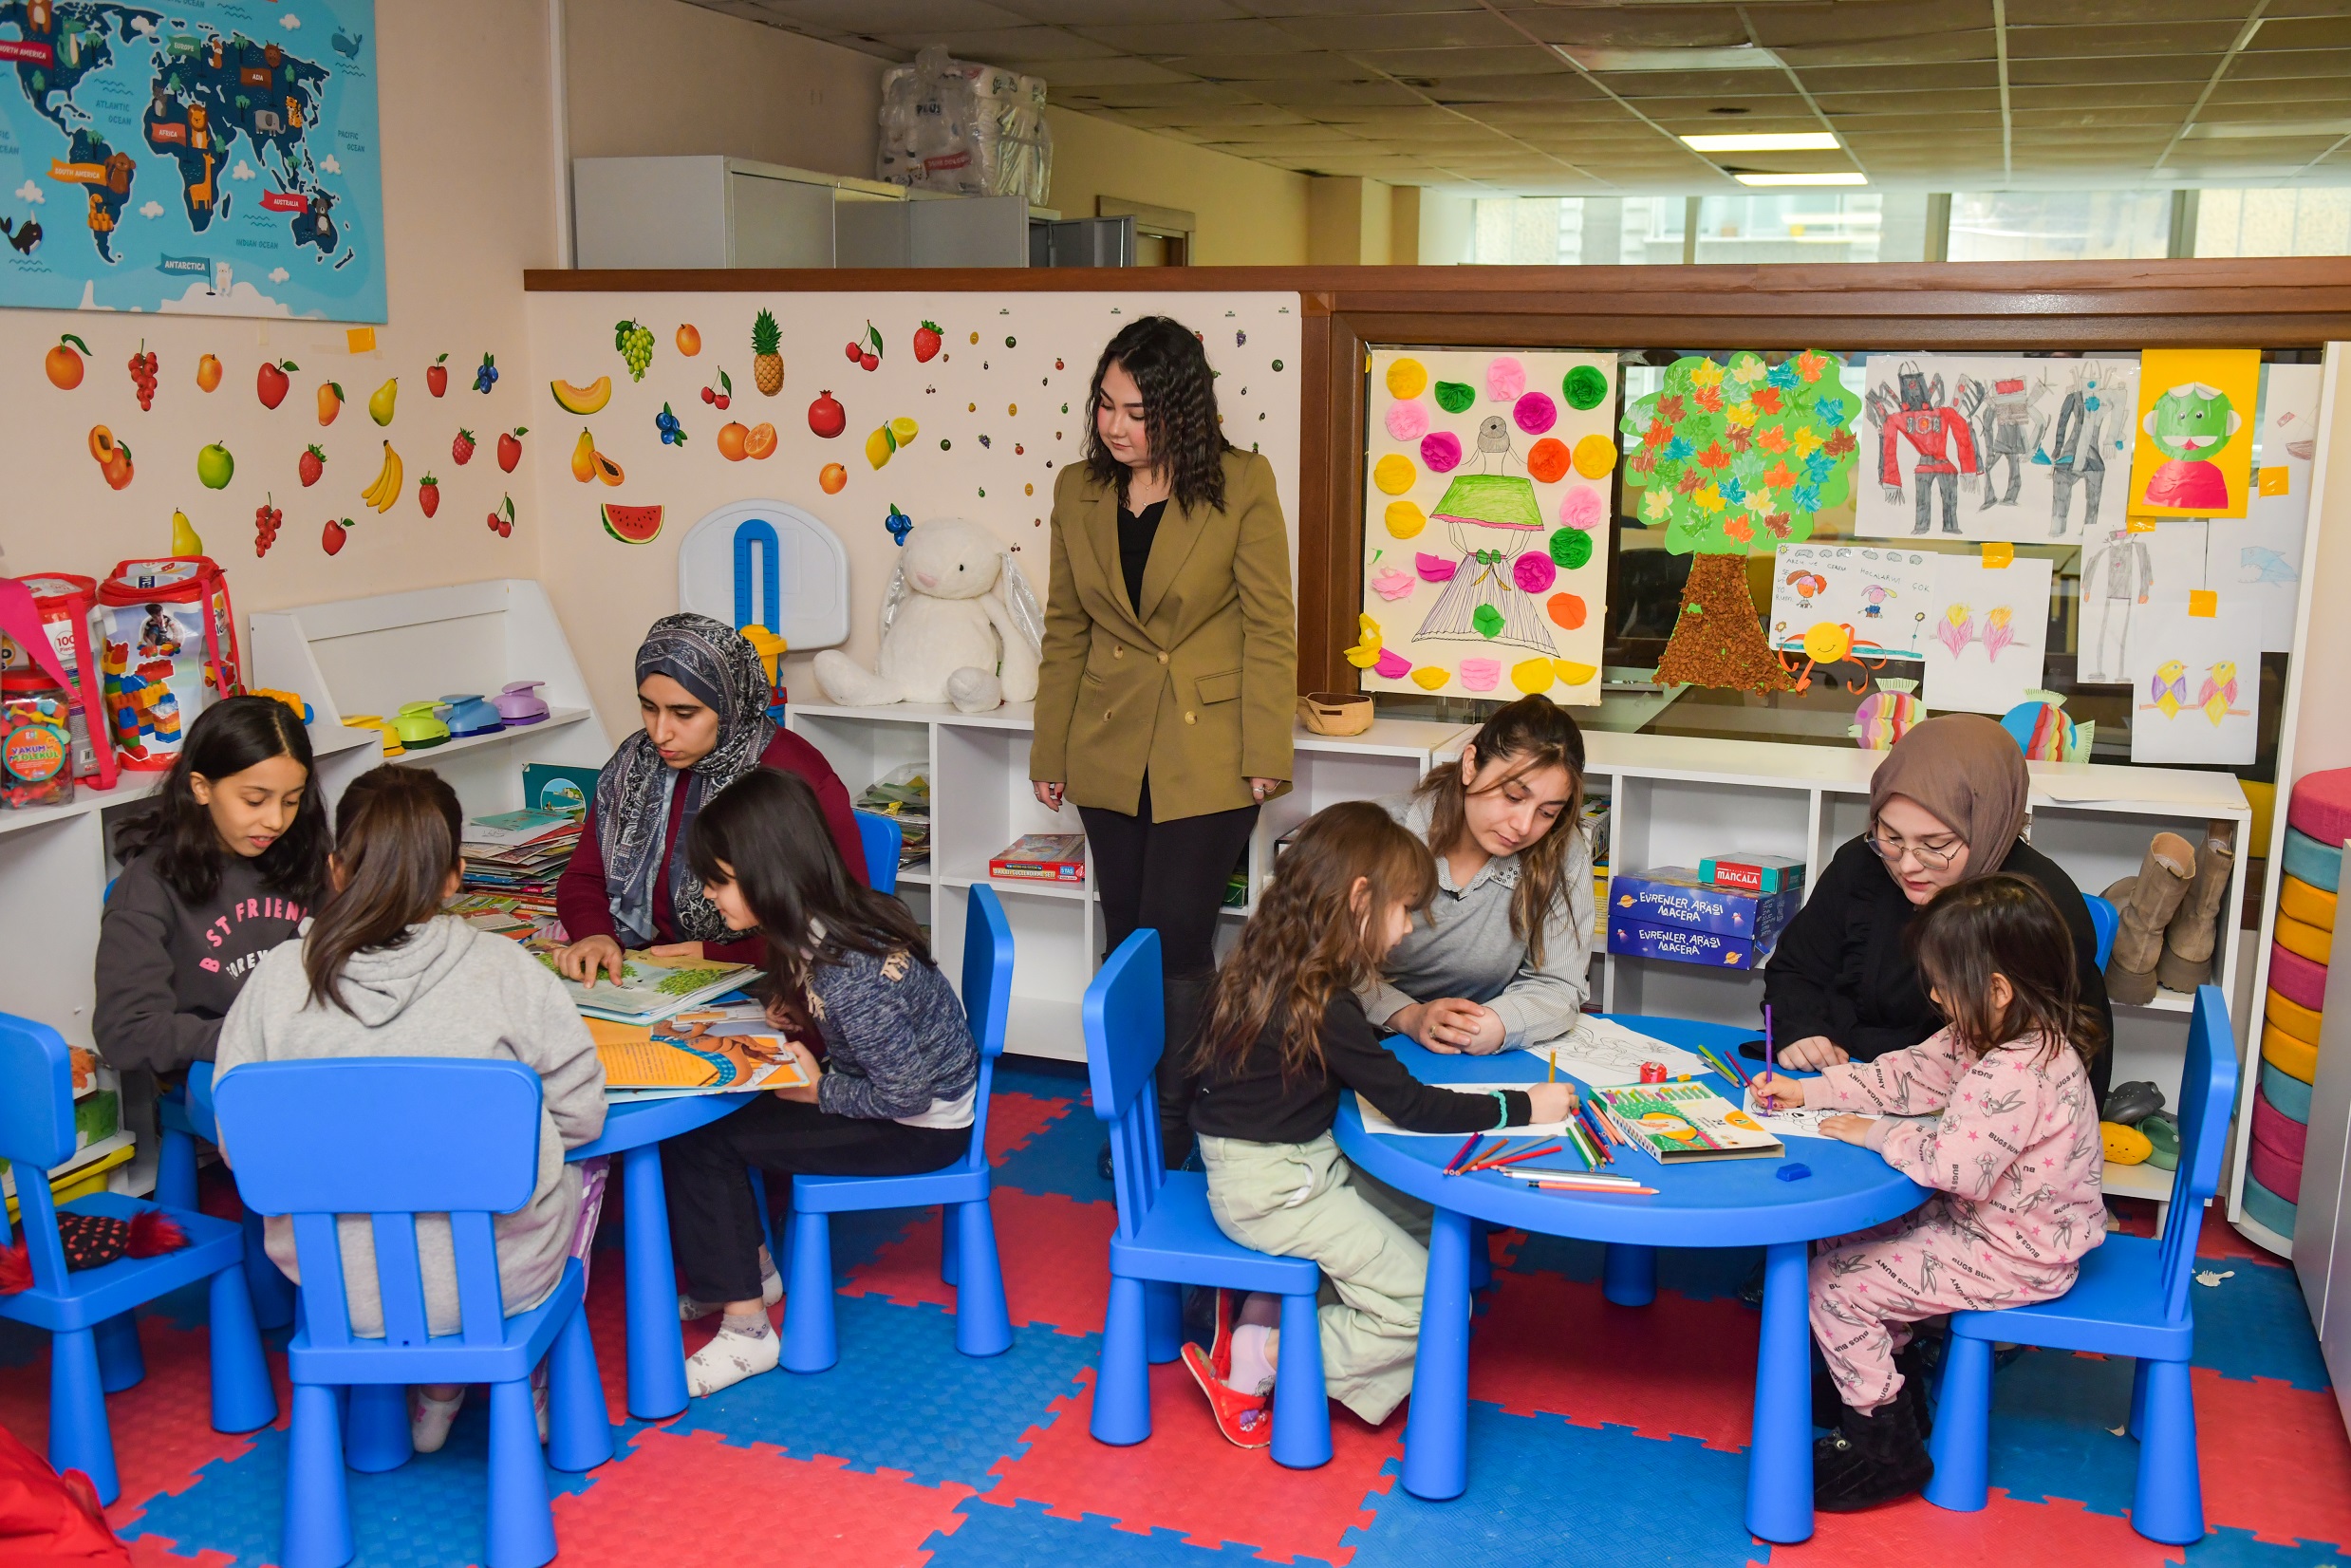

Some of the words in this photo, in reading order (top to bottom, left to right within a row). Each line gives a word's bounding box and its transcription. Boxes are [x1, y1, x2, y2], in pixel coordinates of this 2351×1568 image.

[174, 42, 195, 52] EUROPE
[19, 48, 47, 60] AMERICA
[252, 73, 264, 82] ASIA
[95, 100, 130, 112] ATLANTIC
[108, 116, 132, 126] OCEAN
[159, 129, 178, 139] AFRICA
[337, 129, 359, 140] PACIFIC
[0, 144, 20, 156] CEAN
[346, 143, 365, 153] OCEAN
[55, 167, 74, 177] SOUTH
[75, 169, 101, 179] AMERICA
[273, 198, 299, 208] AUSTRALIA
[236, 239, 256, 248] INDIAN
[258, 240, 279, 250] OCEAN
[164, 260, 206, 271] ANTARCTICA
[9, 749, 60, 763] MOLEKÜL
[11, 745, 47, 755] VAKUM
[1717, 870, 1758, 885] MANCALA
[1657, 905, 1701, 923] MACERA
[198, 916, 232, 973] BST
[235, 897, 308, 928] FRIEN
[1657, 941, 1701, 955] MACERA
[1971, 1068, 1994, 1080] BUGS
[1866, 1089, 1884, 1108] BUGS
[1988, 1131, 2007, 1148] BUGS
[2054, 1203, 2070, 1215] BUGS
[2022, 1239, 2040, 1258] BUGS
[1875, 1259, 1896, 1279] BUNY
[1951, 1257, 1973, 1273] BUGS
[1896, 1278, 1920, 1296] BUGS
[1850, 1331, 1869, 1345] BUGS
